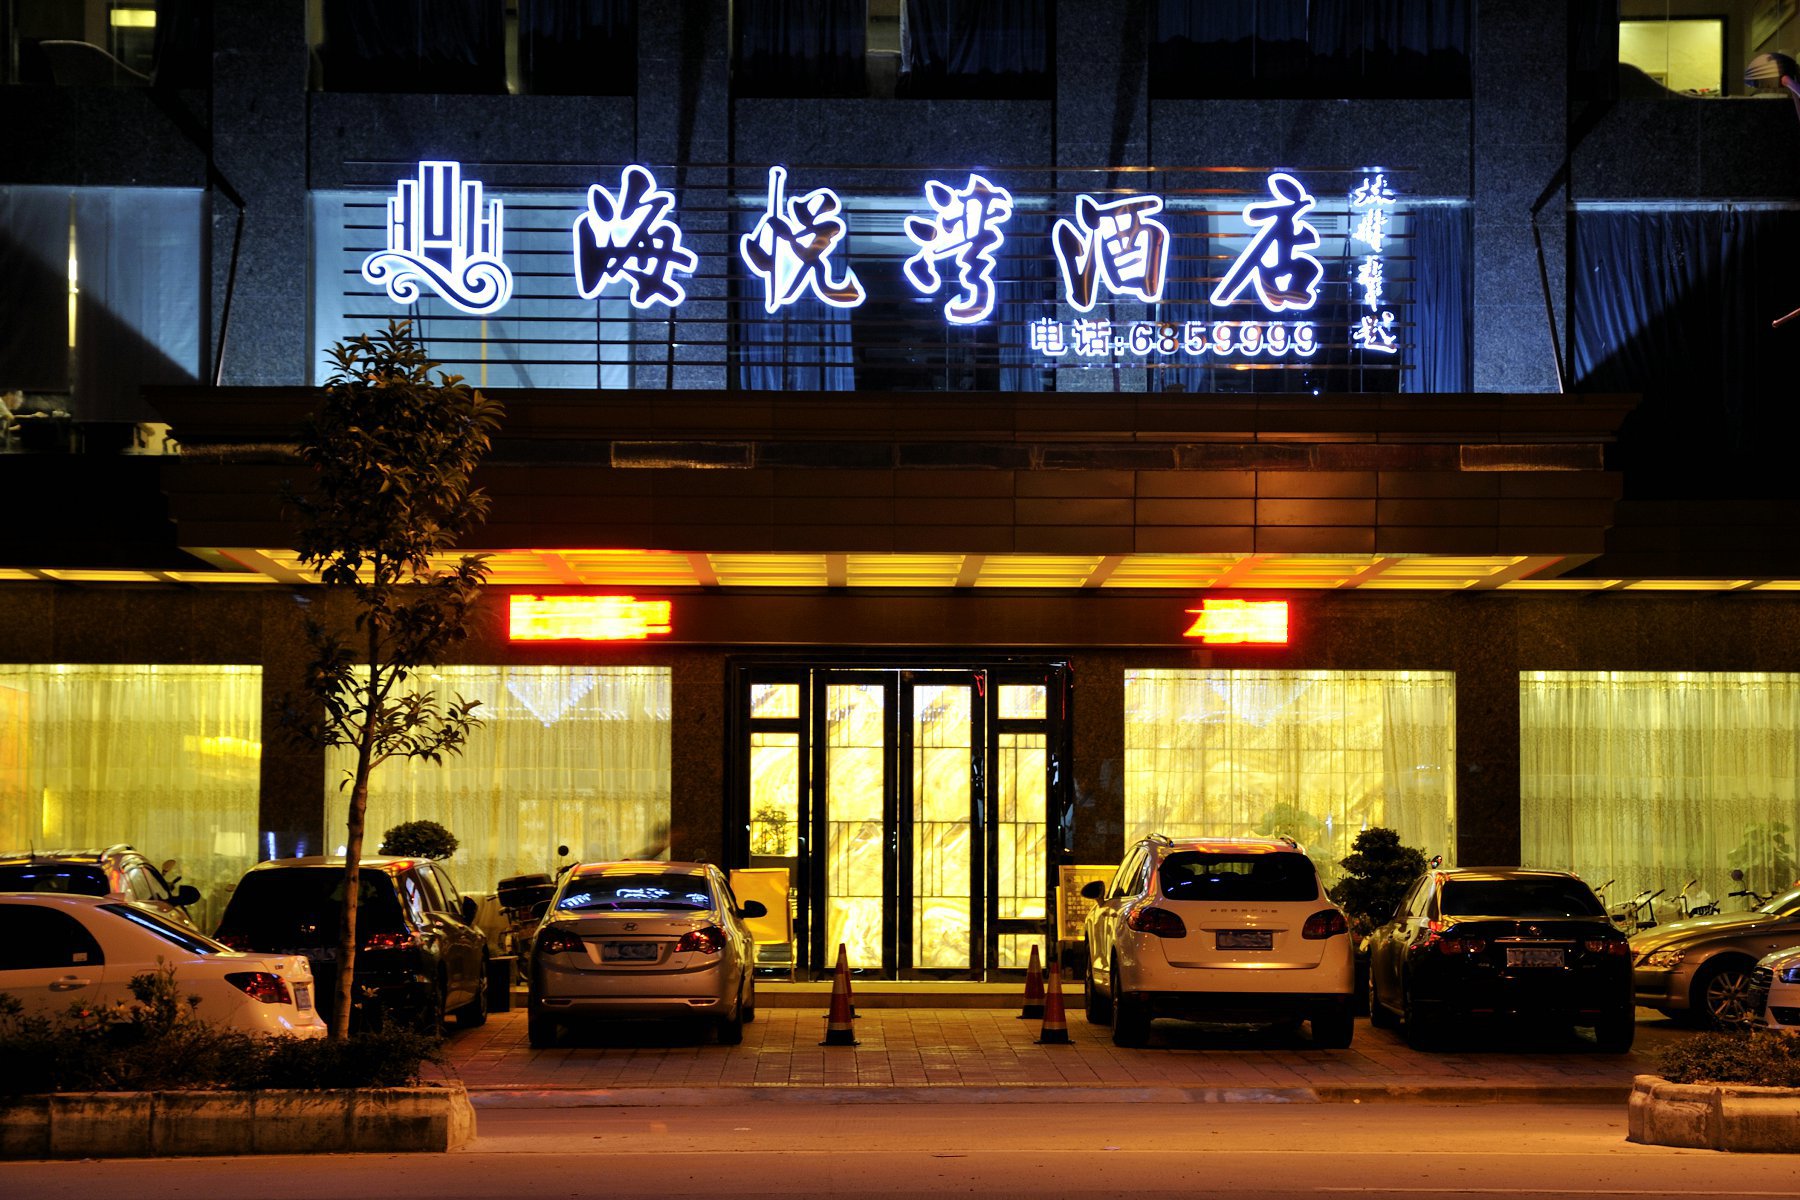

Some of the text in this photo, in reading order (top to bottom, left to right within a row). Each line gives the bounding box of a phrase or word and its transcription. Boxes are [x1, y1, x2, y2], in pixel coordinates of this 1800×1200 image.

[572, 163, 1325, 326] 海悦湾酒店
